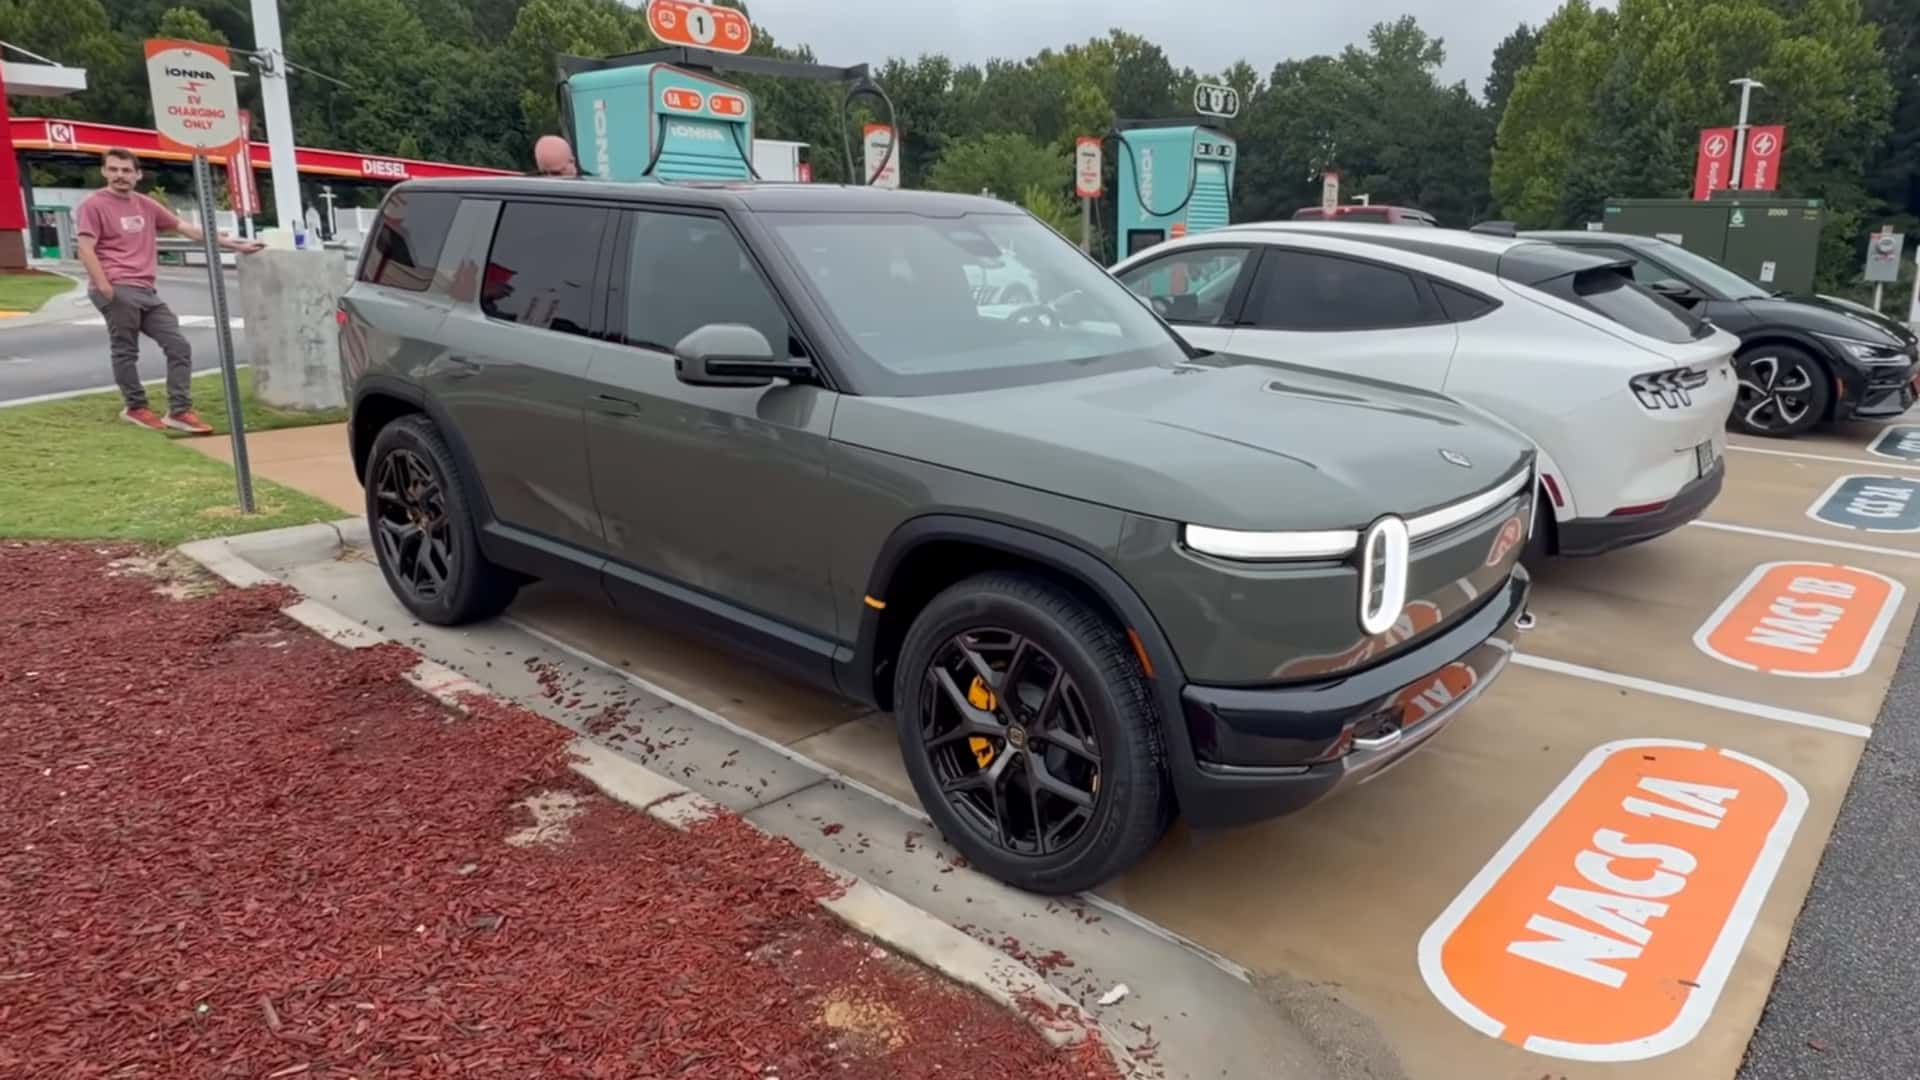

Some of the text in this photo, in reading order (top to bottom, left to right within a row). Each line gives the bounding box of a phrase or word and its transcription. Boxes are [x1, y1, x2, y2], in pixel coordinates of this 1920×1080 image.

[696, 15, 705, 35] 1
[187, 95, 202, 105] EV
[167, 106, 226, 118] CHARGING
[184, 120, 213, 130] ONLY
[362, 160, 410, 178] DIESEL
[1744, 576, 1857, 655] NACS 1B
[1506, 776, 1740, 989] NACS 1A
